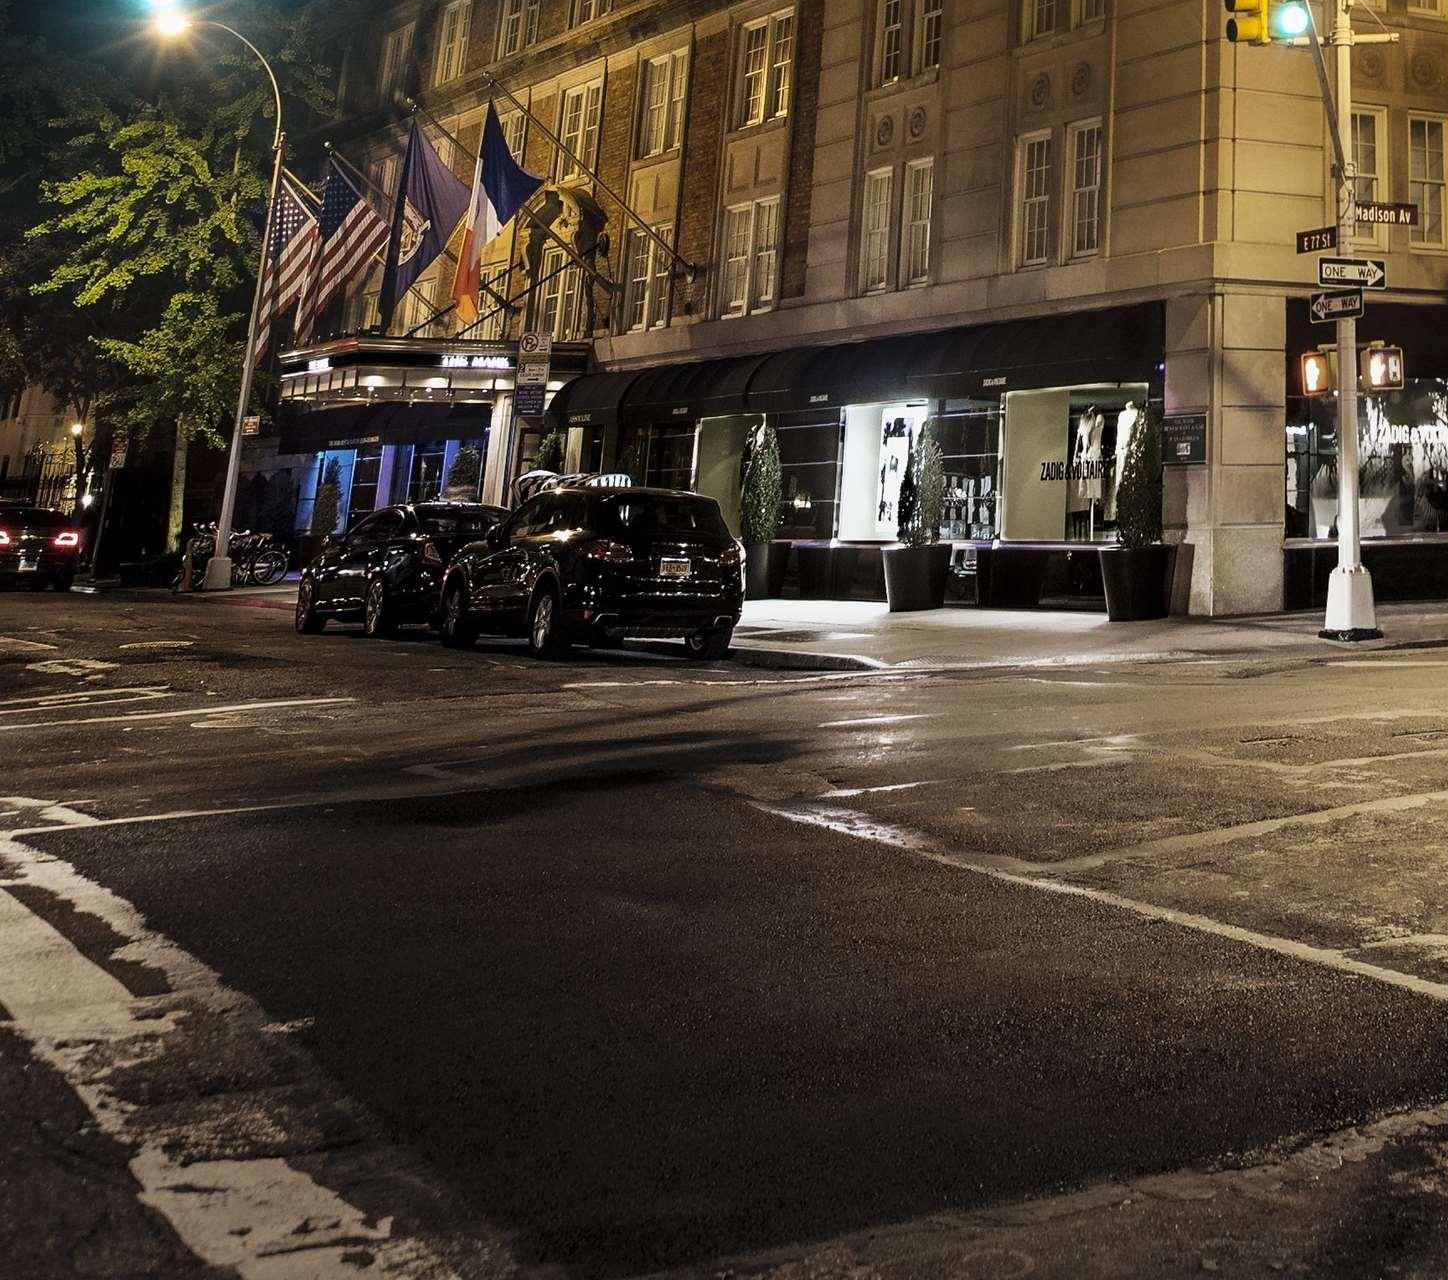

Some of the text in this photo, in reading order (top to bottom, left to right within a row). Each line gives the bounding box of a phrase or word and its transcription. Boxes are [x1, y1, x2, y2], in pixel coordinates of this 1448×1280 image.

[1355, 206, 1411, 224] Madison Av
[1304, 237, 1308, 251] E
[1310, 235, 1320, 249] 77
[1324, 266, 1378, 279] ONE WAY
[1315, 297, 1358, 313] ONE WAY
